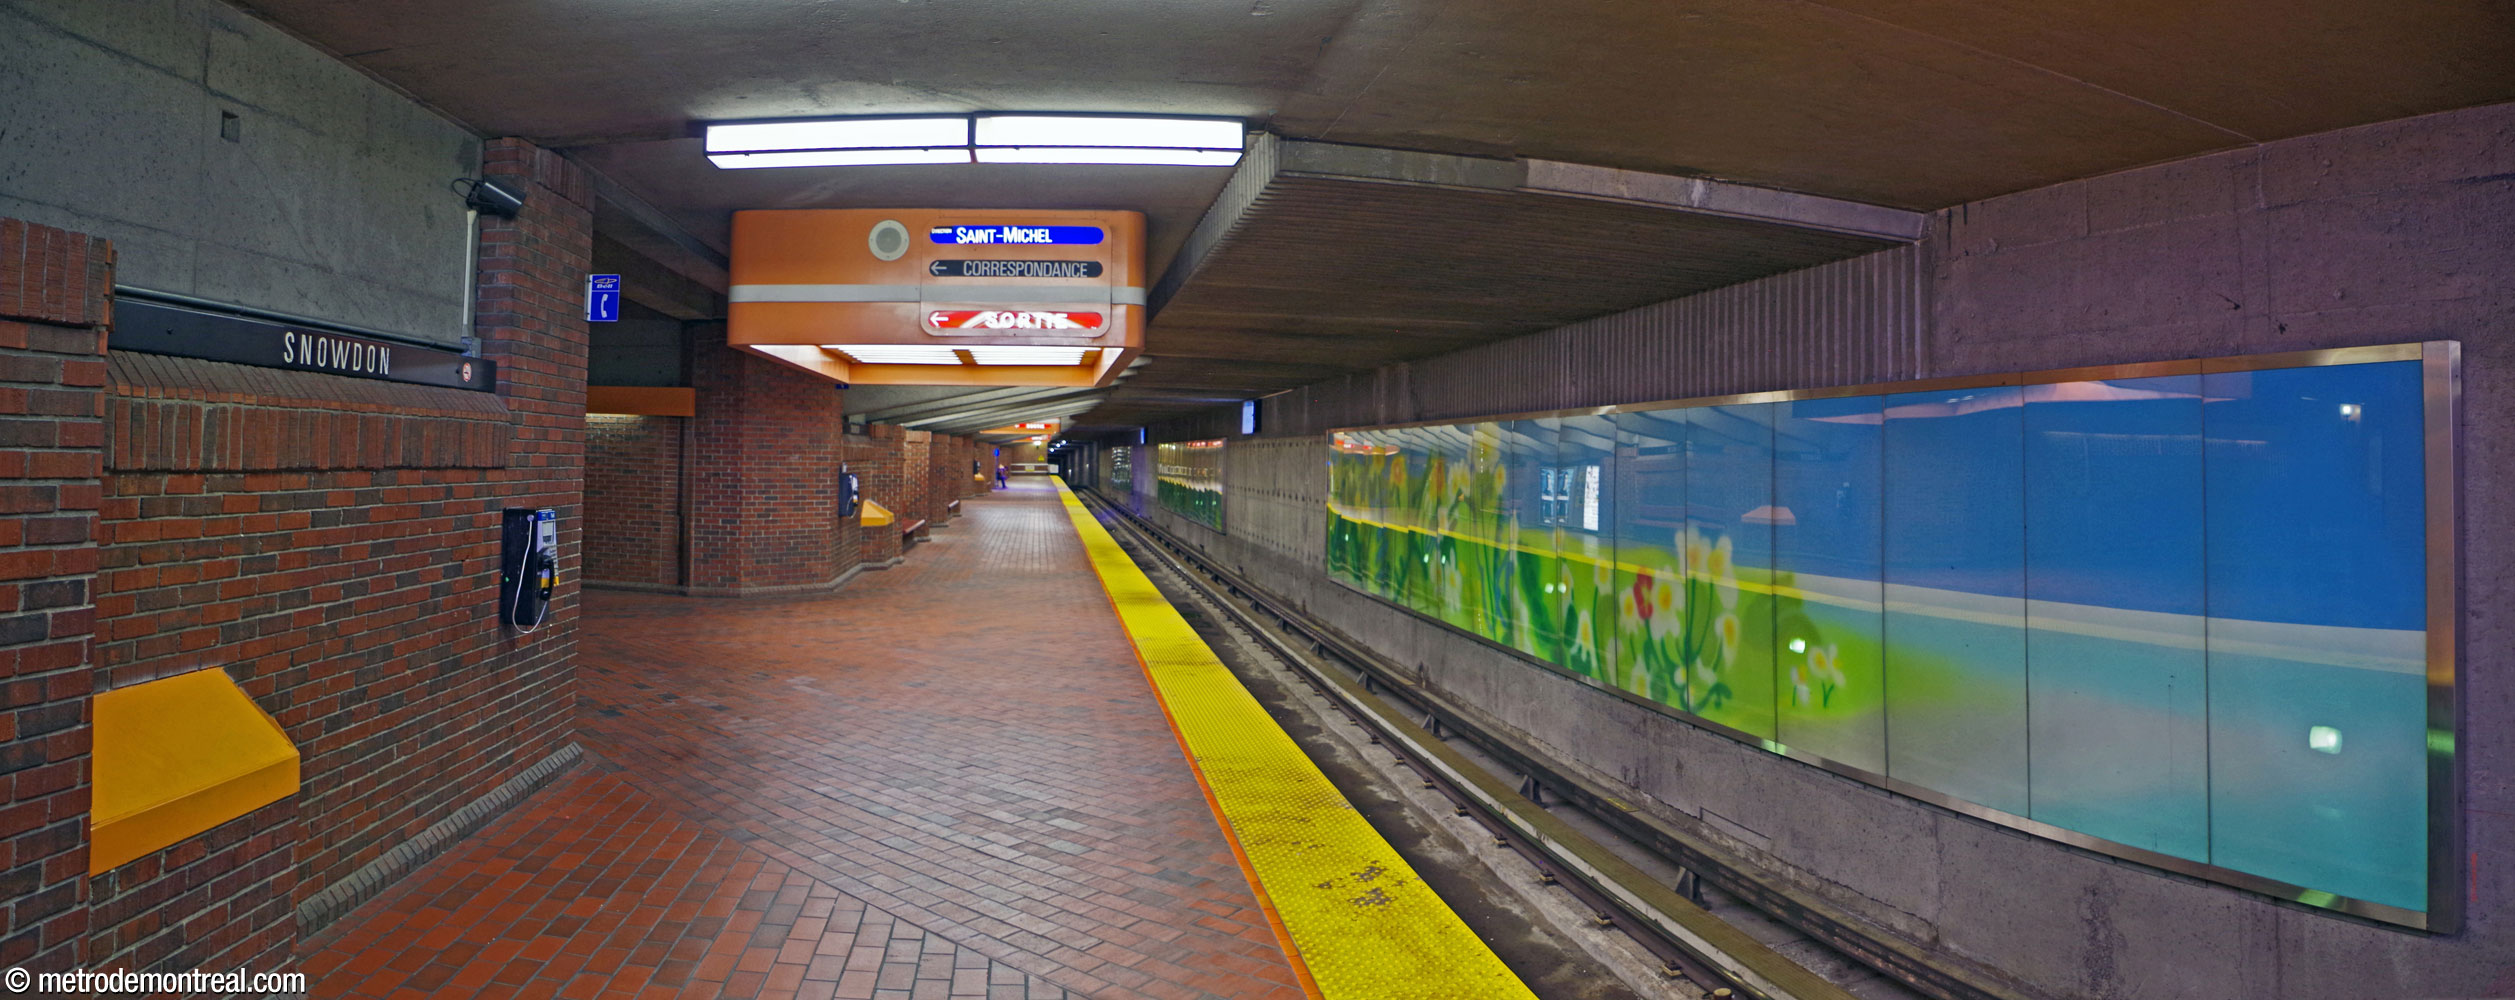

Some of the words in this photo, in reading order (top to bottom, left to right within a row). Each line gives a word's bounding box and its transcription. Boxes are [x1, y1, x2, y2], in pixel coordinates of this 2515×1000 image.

[956, 227, 1053, 244] SAINT-MICHEL
[963, 260, 1088, 278] CORRESPONDANCE
[984, 311, 1069, 329] SORTIE
[283, 331, 390, 376] SNOWDON
